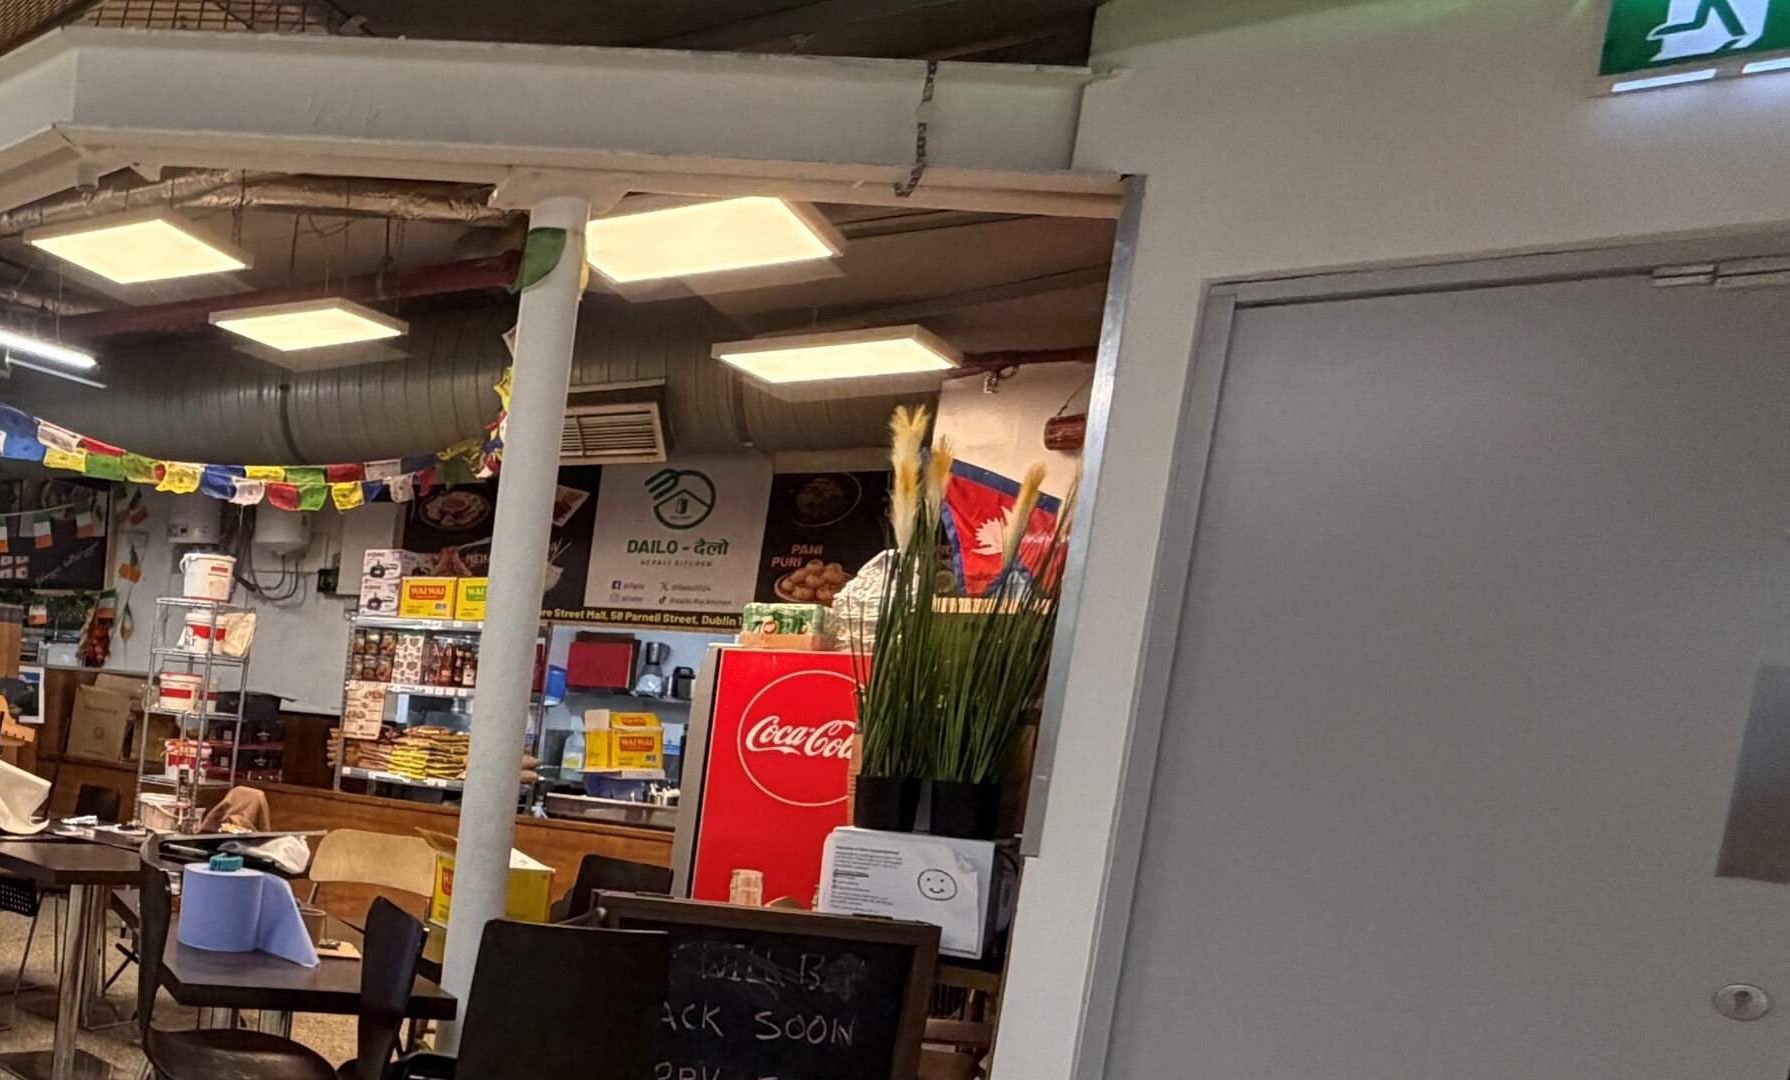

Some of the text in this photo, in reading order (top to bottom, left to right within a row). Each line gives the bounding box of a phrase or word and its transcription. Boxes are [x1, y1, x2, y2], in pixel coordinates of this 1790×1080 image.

[627, 539, 678, 554] DAILO
[791, 544, 823, 555] PANI
[640, 559, 714, 568] NEPALI KITCHEN
[771, 556, 802, 568] PURI
[411, 586, 445, 596] WAI WAI
[467, 587, 484, 596] WAI
[554, 608, 584, 619] Street
[586, 610, 609, 621] Mall,
[610, 611, 624, 621] 58
[625, 611, 660, 623] Parnell
[662, 613, 699, 626] Street,
[701, 615, 737, 627] Dublin
[621, 737, 653, 748] WAI WAI
[746, 715, 856, 760] Coca-Col
[660, 999, 858, 1047] ACK SOON
